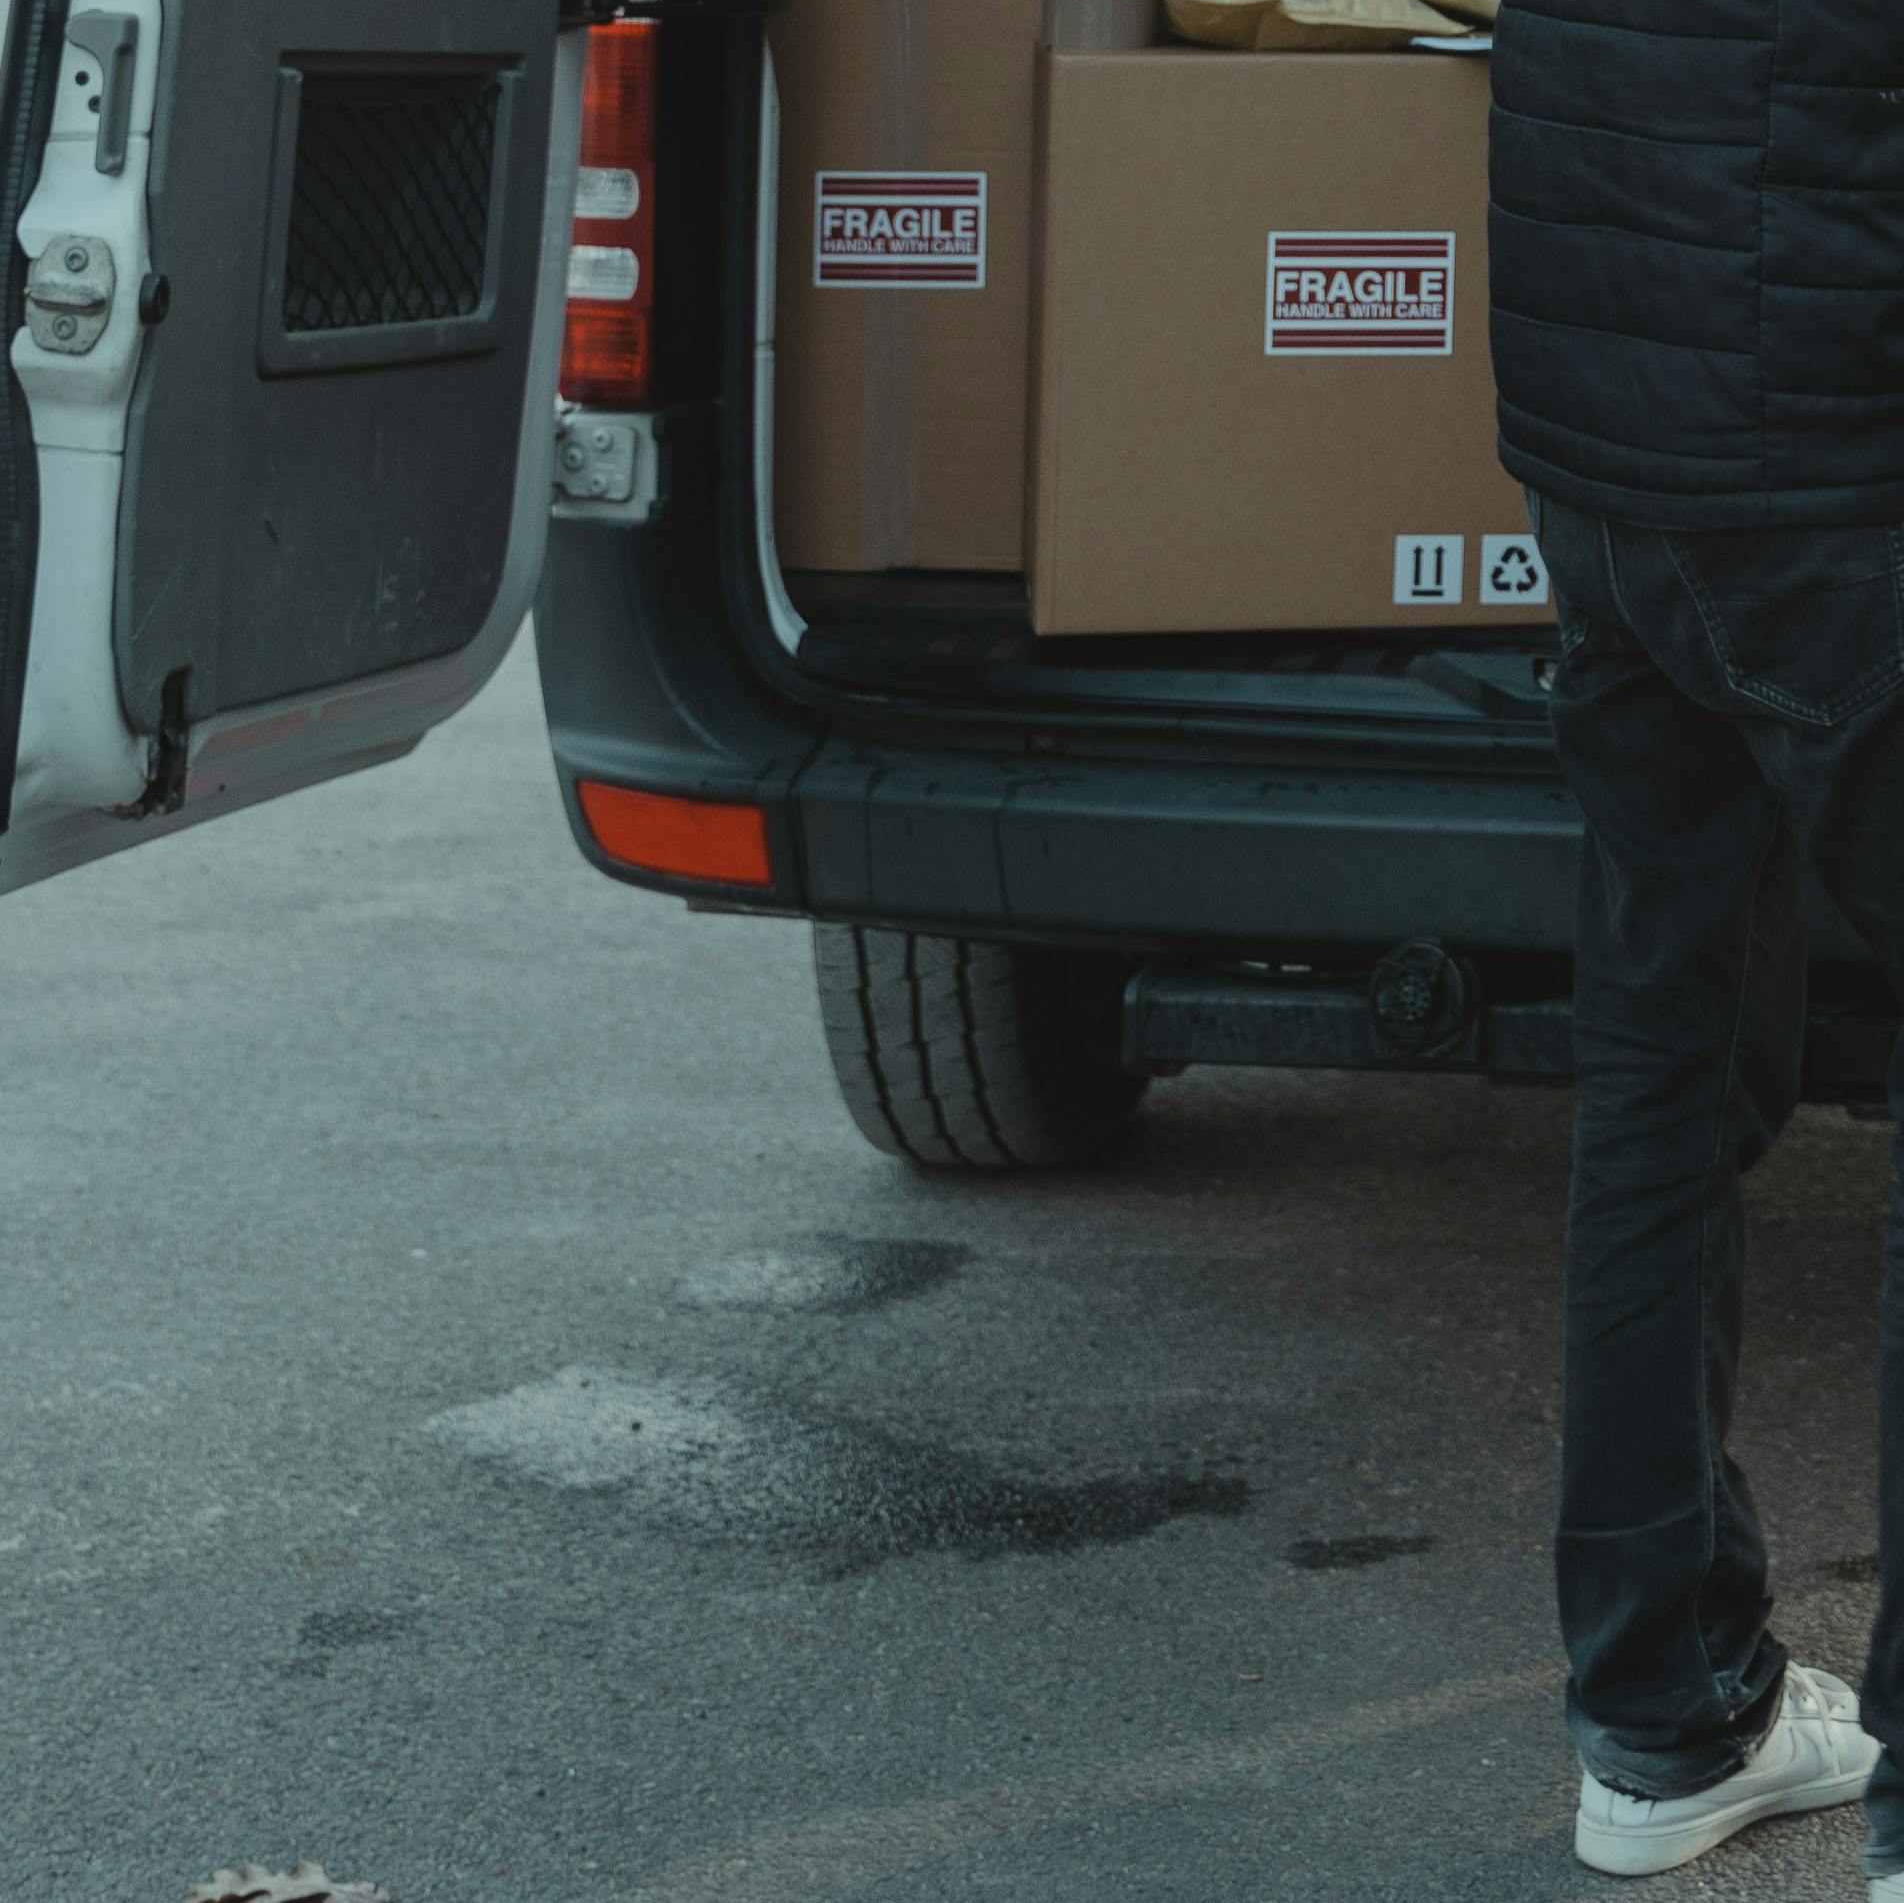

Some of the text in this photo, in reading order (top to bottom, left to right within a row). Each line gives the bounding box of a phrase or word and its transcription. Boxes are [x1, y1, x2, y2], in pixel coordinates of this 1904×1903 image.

[823, 208, 976, 239] FRAGILE
[825, 239, 976, 253] HANDLE WITH CARE
[1276, 270, 1444, 303] FRAGILE
[1275, 303, 1443, 318] HANDLE WITH CARE
